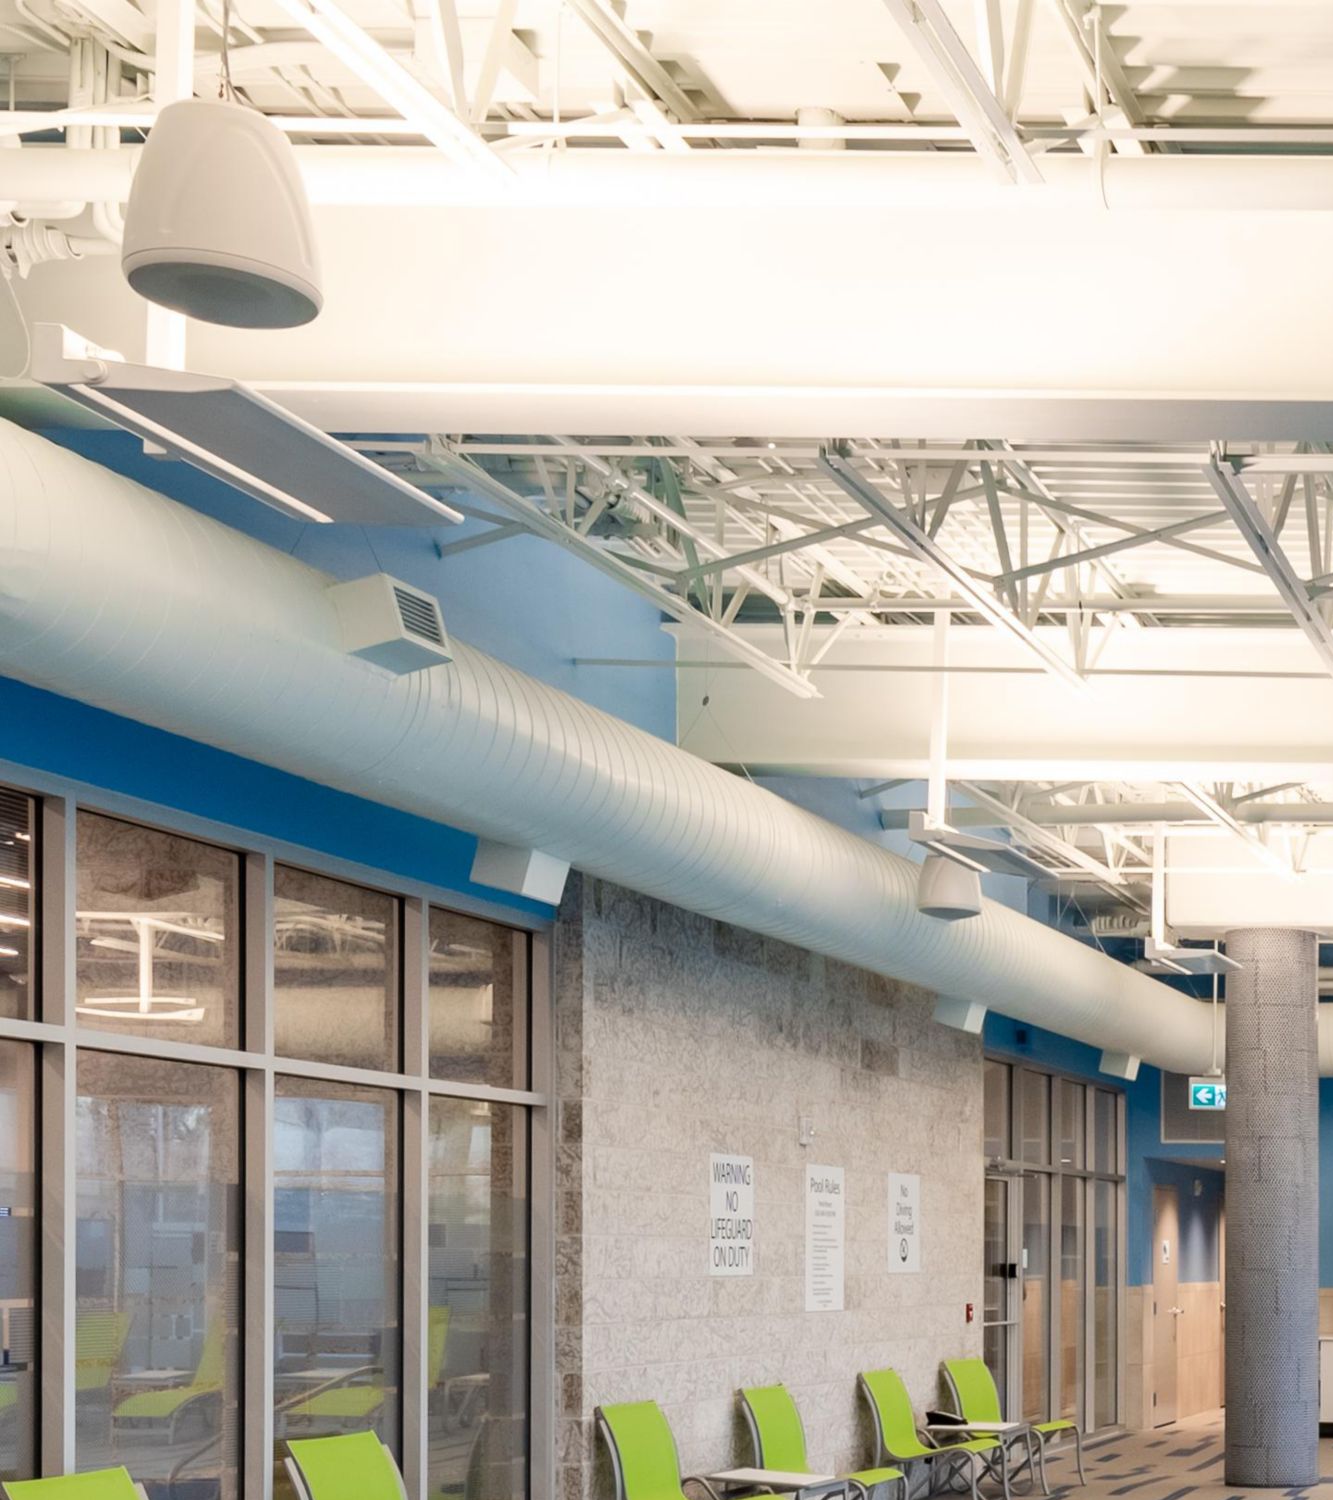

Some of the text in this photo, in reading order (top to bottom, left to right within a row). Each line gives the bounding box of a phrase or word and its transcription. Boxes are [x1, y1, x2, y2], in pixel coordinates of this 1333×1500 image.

[712, 1161, 751, 1186] WARNING
[810, 1176, 841, 1195] Pool Rules
[726, 1191, 739, 1212] NO
[711, 1218, 753, 1240] LIFEGUARD
[713, 1246, 750, 1267] ON DUTY
